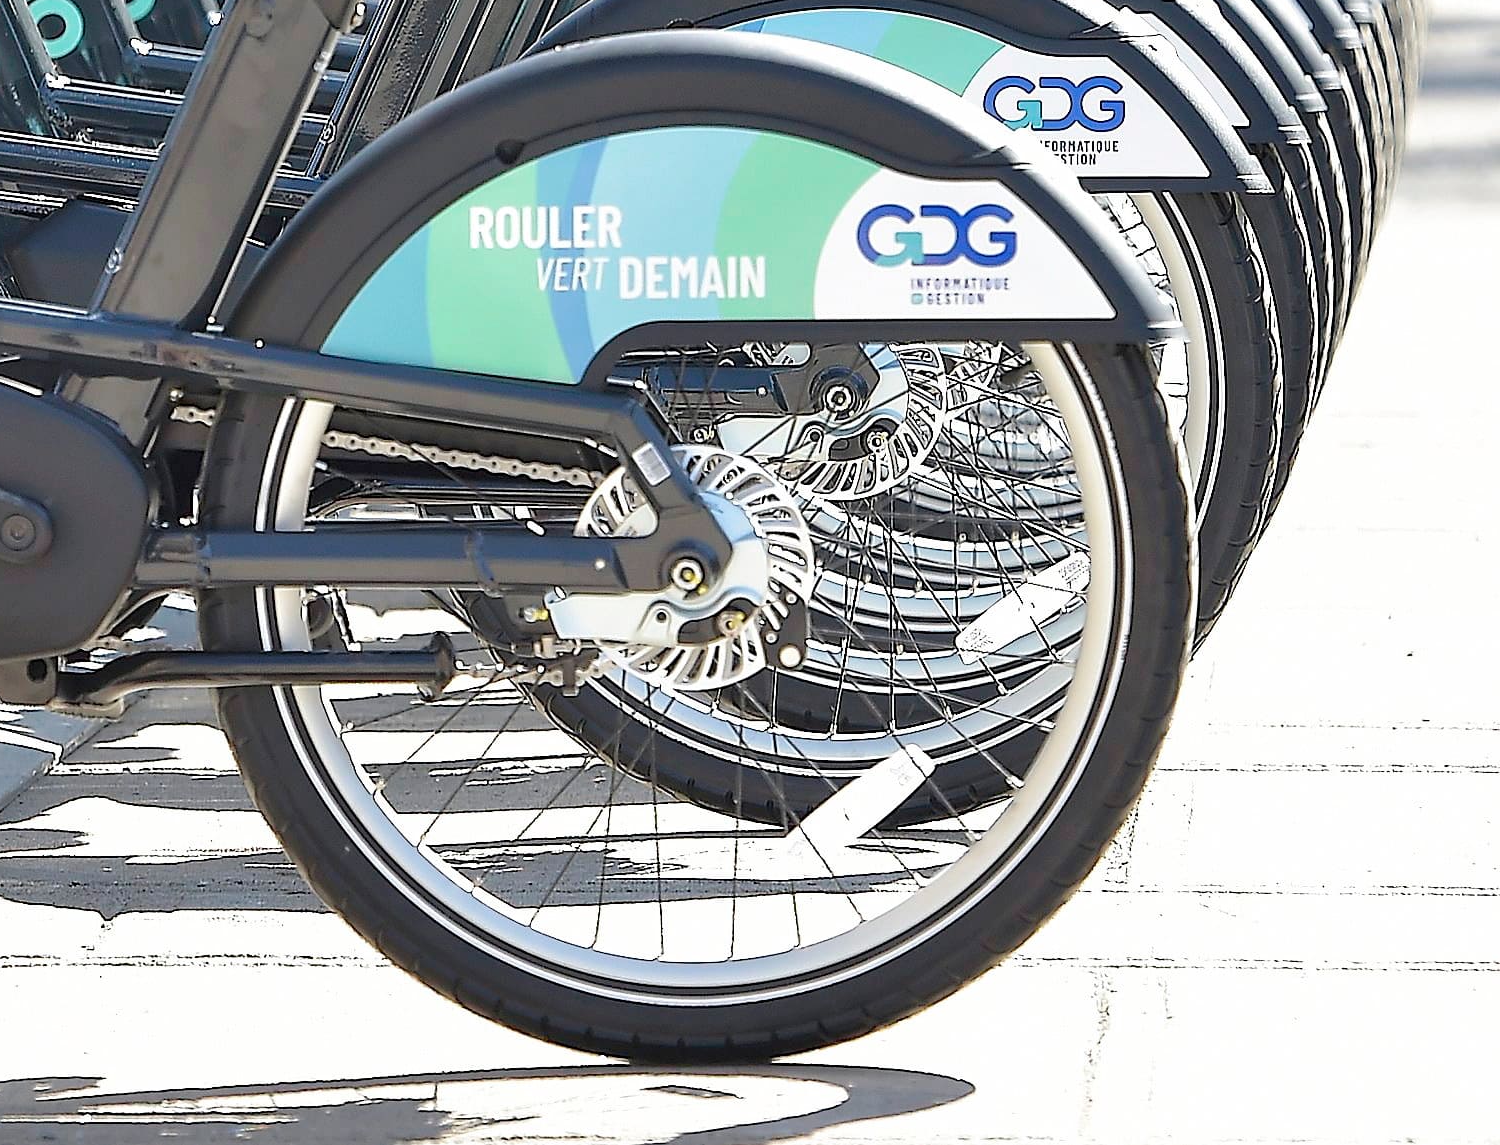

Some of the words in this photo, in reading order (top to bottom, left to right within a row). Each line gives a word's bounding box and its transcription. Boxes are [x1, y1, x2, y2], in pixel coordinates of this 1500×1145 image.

[1040, 140, 1119, 153] FORMATIQUE
[1054, 153, 1096, 165] STION
[469, 206, 622, 249] ROULER
[857, 204, 1017, 267] GDG
[536, 257, 609, 292] VERT
[618, 256, 766, 299] DEMAIN
[910, 278, 1010, 291] INFORMATIQUE
[927, 293, 985, 305] GESTION
